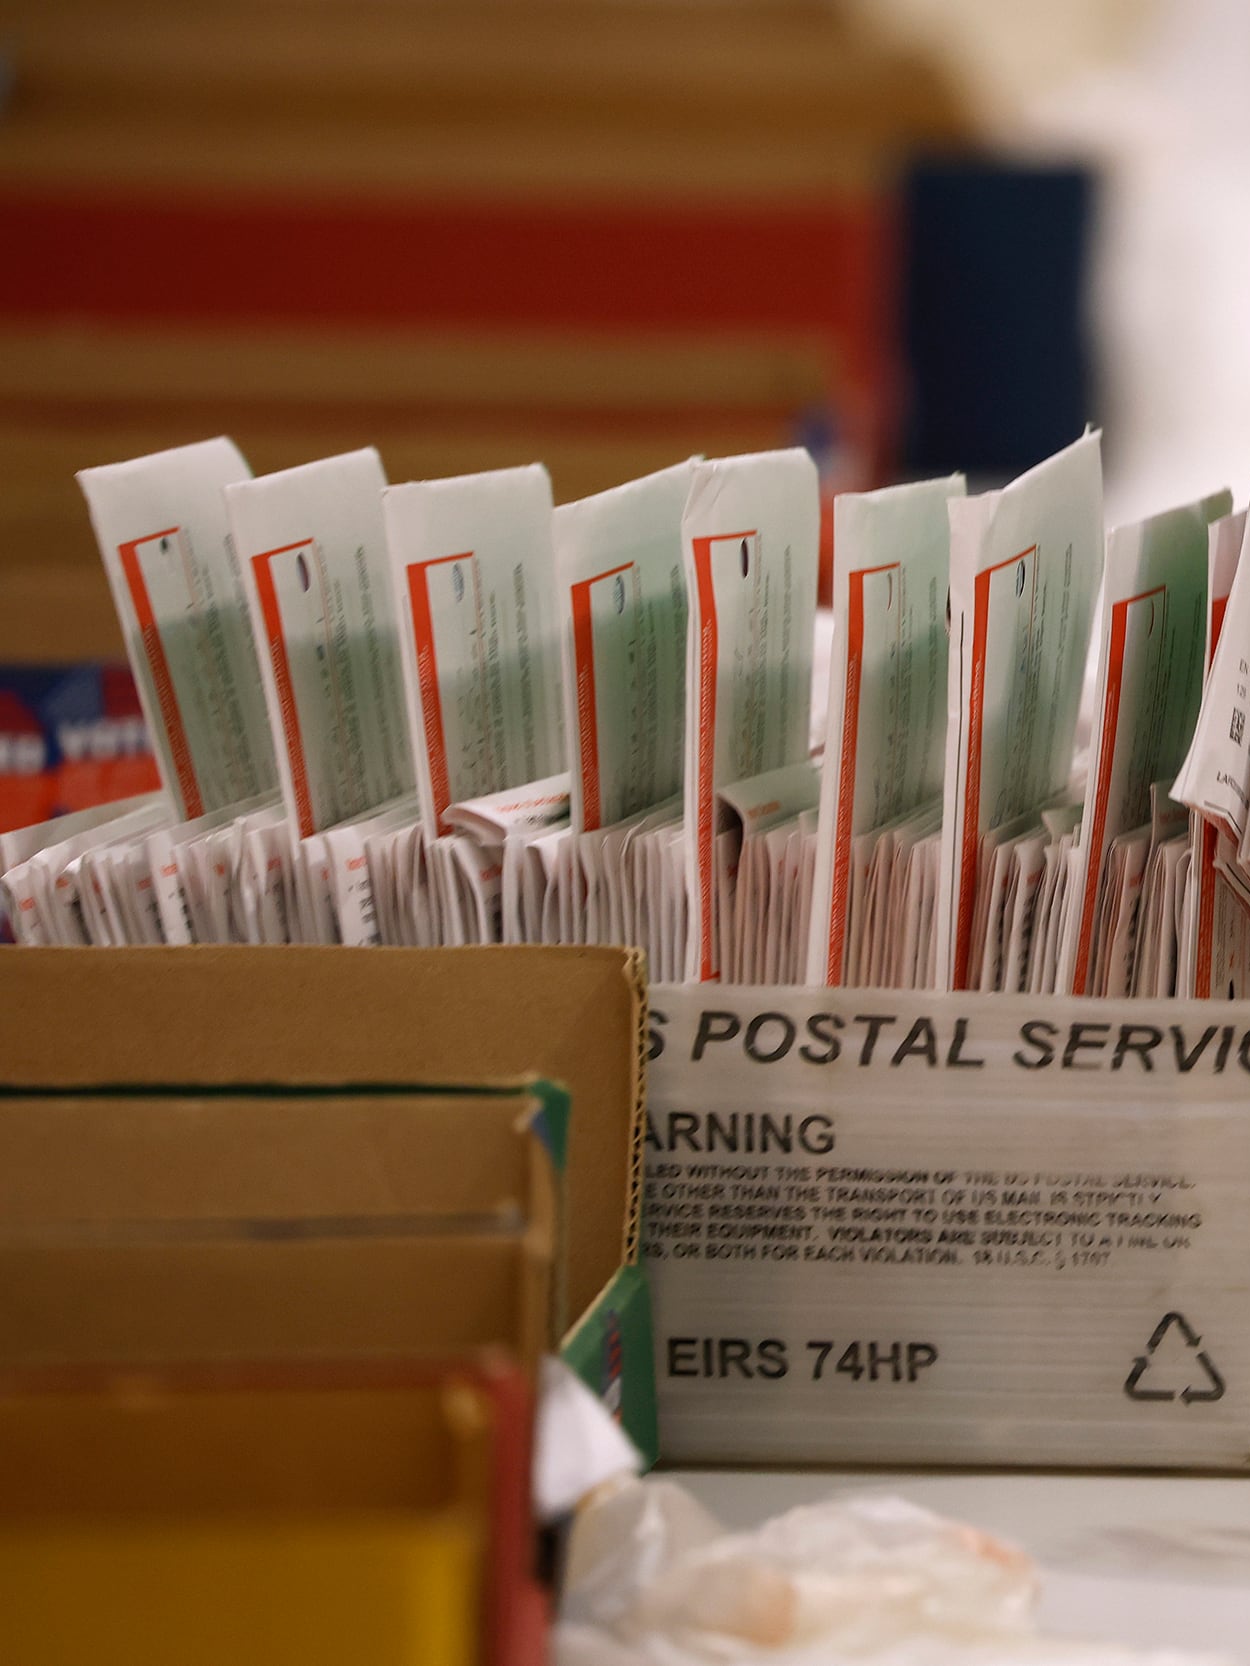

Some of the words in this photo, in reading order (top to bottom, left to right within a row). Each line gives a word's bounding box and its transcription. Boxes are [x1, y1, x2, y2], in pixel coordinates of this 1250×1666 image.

[691, 1010, 985, 1068] POSTAL
[687, 1164, 771, 1181] WITHOUT
[775, 1166, 812, 1181] THE
[816, 1166, 928, 1184] PERMISSION
[933, 1169, 956, 1184] OF
[661, 1183, 725, 1200] OTHER
[731, 1184, 780, 1201] THAN
[784, 1185, 820, 1201] THE
[827, 1185, 935, 1204] TRANSPORT
[943, 1189, 966, 1205] OF
[706, 1203, 806, 1221] RESERVES
[810, 1205, 847, 1221] THE
[852, 1207, 906, 1222] RIGHT
[912, 1208, 938, 1224] TO
[942, 1209, 980, 1225] USE
[983, 1209, 1102, 1227] ELECTRONIC
[1106, 1212, 1203, 1229] TRACKING
[650, 1222, 702, 1240] THEIR
[827, 1225, 934, 1245] VIOLATORS
[937, 1229, 976, 1246] ARE
[980, 1229, 1063, 1247] SUBJECT
[1071, 1232, 1095, 1248] TO
[672, 1243, 702, 1260] OR
[705, 1242, 757, 1261] BOTH
[761, 1243, 799, 1261] FOR
[804, 1245, 855, 1263] EACH
[667, 1337, 789, 1381] EIRS
[807, 1341, 939, 1383] 74HP
